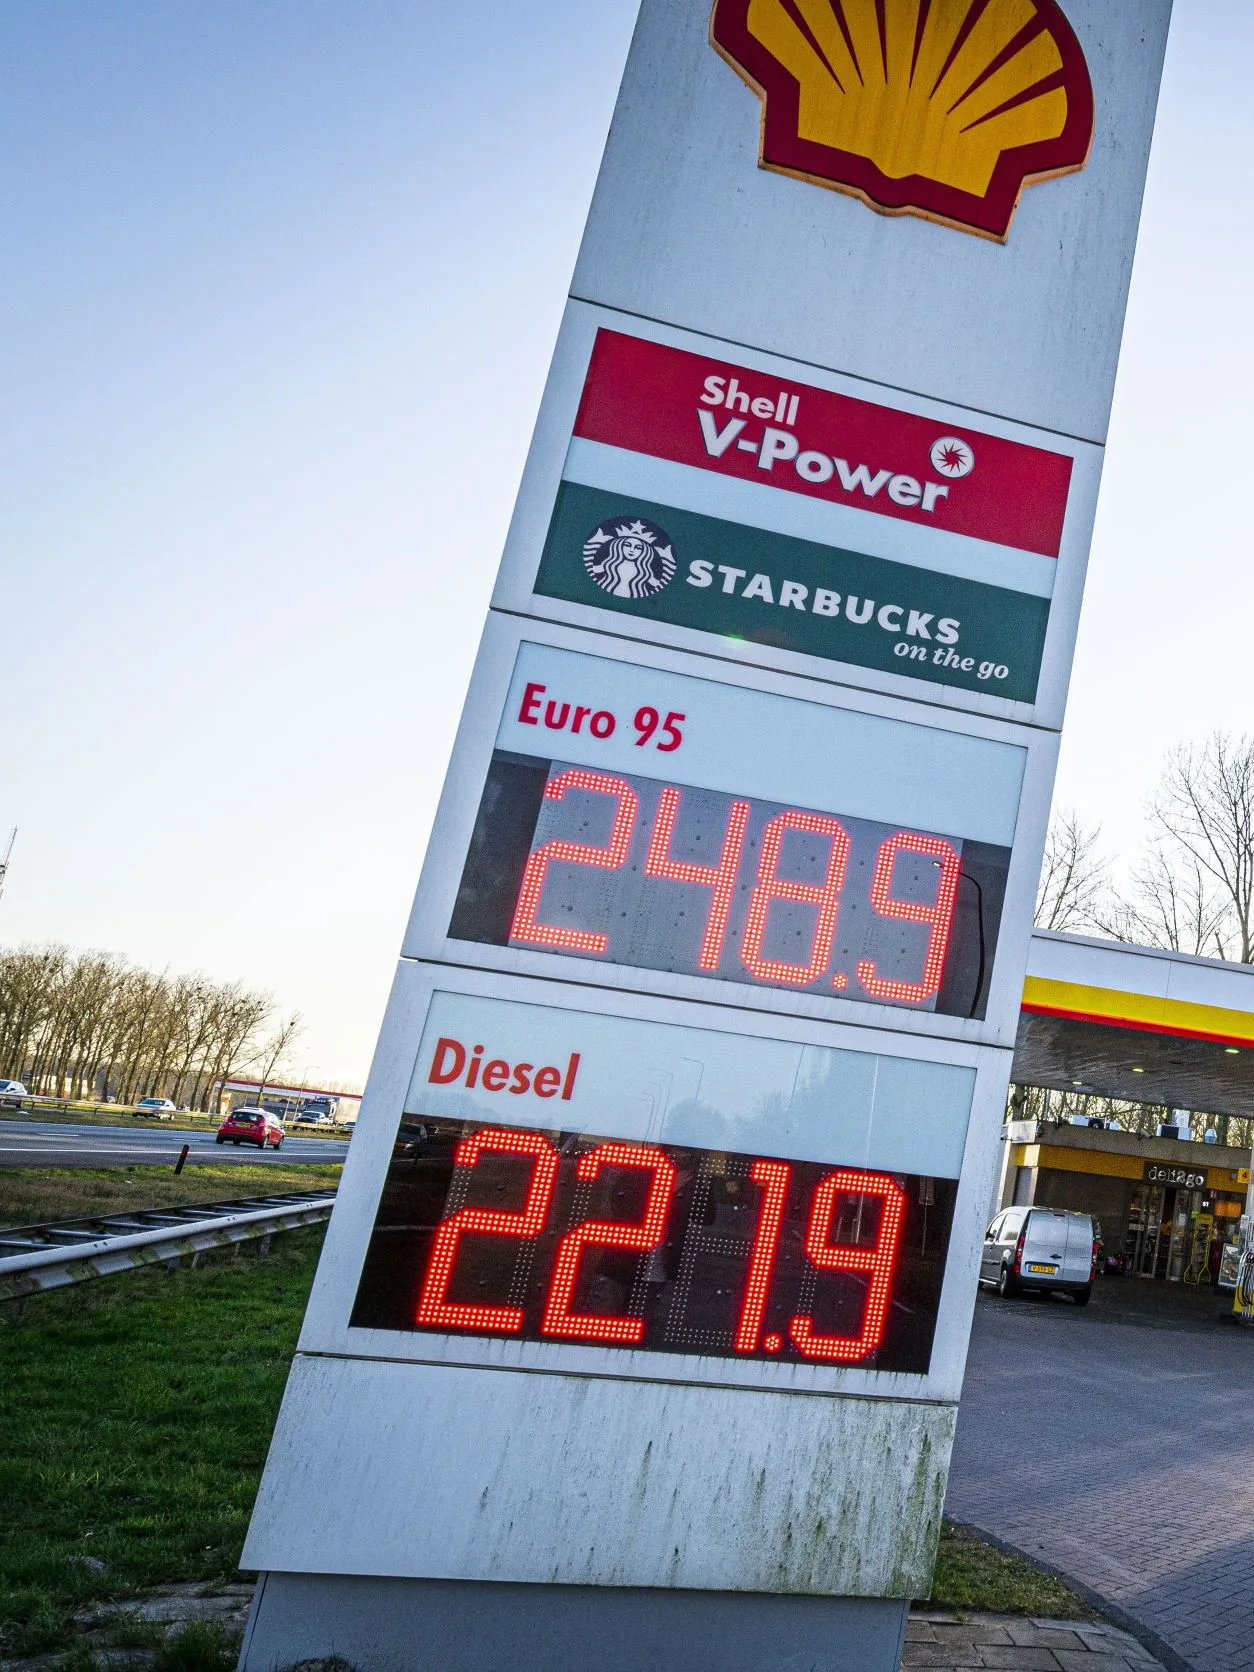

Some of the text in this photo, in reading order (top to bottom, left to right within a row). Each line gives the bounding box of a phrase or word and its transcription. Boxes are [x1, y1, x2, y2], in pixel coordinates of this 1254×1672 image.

[700, 374, 800, 426] Shell
[696, 407, 951, 514] V-Power
[686, 558, 961, 645] STARBUCKS
[893, 639, 1009, 681] on the go
[516, 682, 687, 754] Euro 95
[508, 768, 962, 1004] 248.9
[427, 1036, 582, 1101] Diesel
[415, 1128, 906, 1363] 221.9
